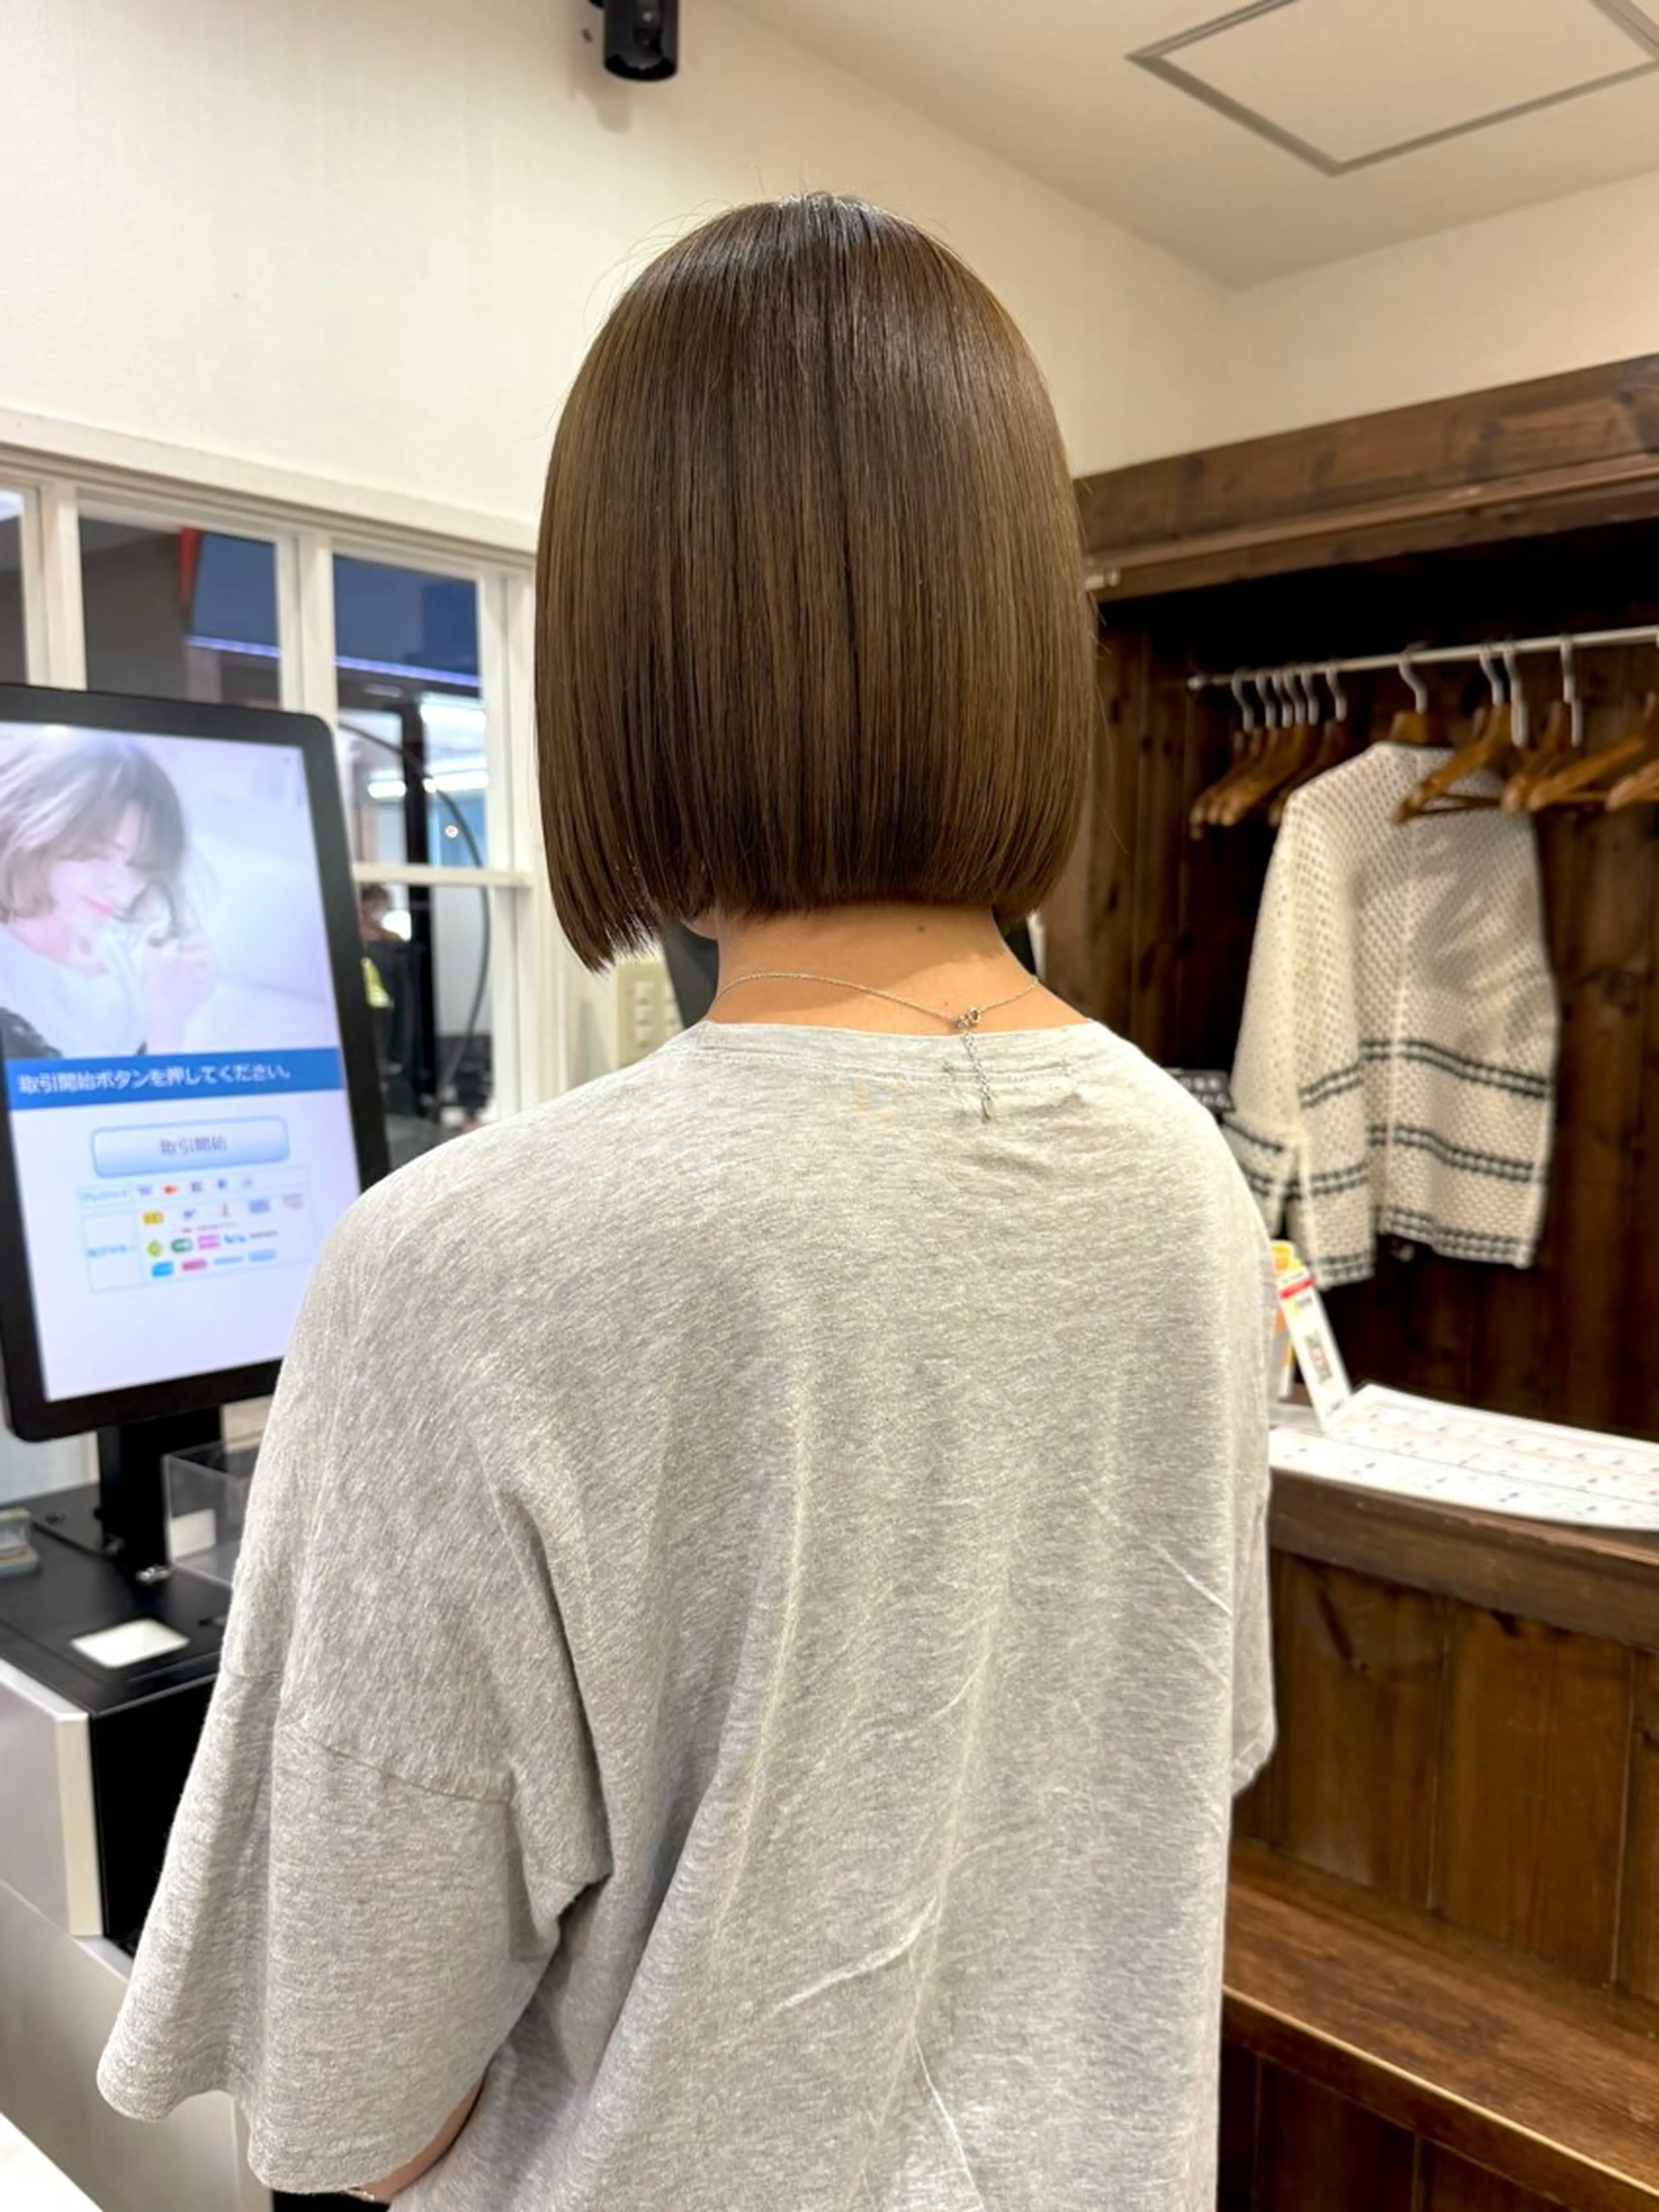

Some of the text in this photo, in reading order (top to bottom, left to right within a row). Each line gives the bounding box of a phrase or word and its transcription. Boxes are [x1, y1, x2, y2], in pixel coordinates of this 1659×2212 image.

[18, 1063, 291, 1094] 取引開始ボタンを押してください。
